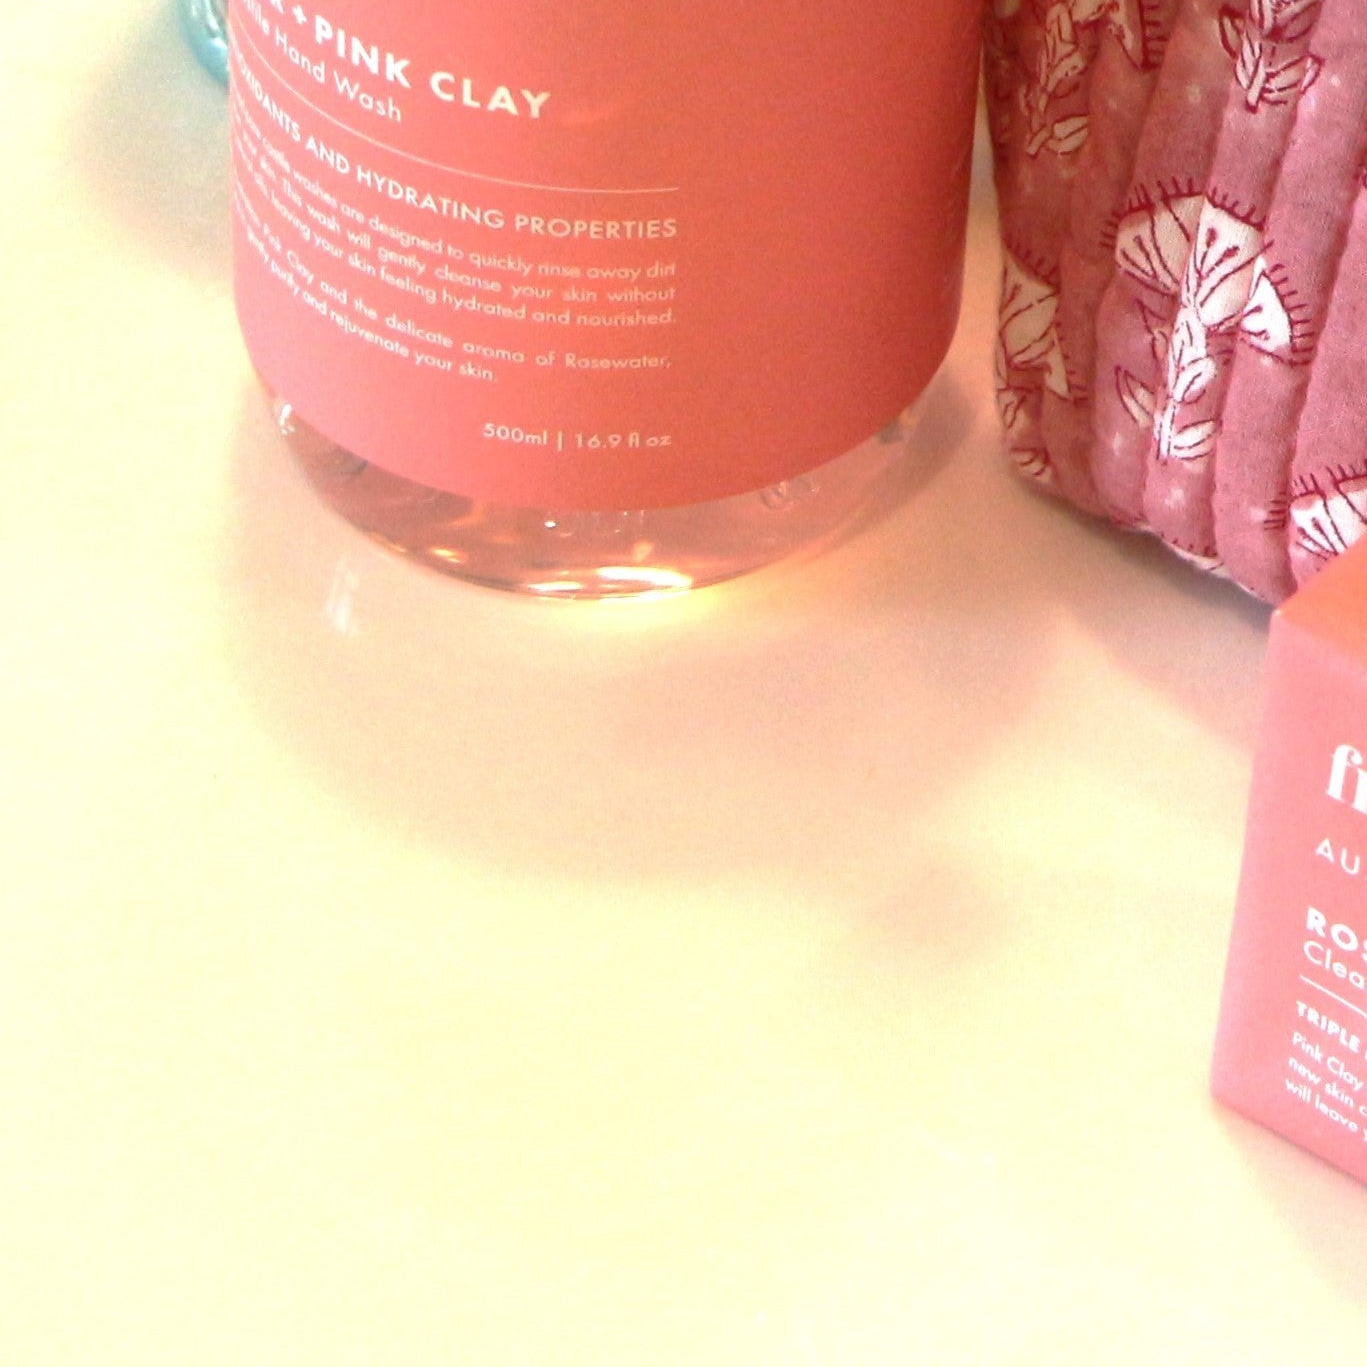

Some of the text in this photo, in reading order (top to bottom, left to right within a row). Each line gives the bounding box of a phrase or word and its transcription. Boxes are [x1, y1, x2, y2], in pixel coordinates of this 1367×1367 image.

[275, 26, 325, 84] Hand
[333, 69, 401, 122] Wash
[315, 14, 411, 89] PINK
[430, 71, 551, 119] CLAY
[305, 136, 350, 174] AND
[357, 164, 505, 229] HYDRATING
[515, 213, 677, 240] PROPERTIES
[313, 232, 344, 260] your
[348, 251, 377, 278] skin
[380, 264, 437, 305] feeling
[442, 286, 527, 322] hydrated
[532, 307, 571, 326] and
[340, 203, 365, 224] are
[369, 213, 443, 255] designed
[447, 244, 464, 261] to
[469, 251, 532, 278] quickly
[538, 263, 581, 279] rinse
[587, 267, 641, 287] away
[646, 260, 676, 279] dirt
[347, 228, 372, 251] will
[377, 245, 426, 276] gently
[434, 264, 502, 293] cleanse
[511, 284, 553, 300] your
[563, 284, 597, 303] skin
[607, 286, 676, 304] without
[302, 290, 328, 316] and
[330, 308, 410, 358] rejuvenate
[413, 350, 453, 373] your
[320, 279, 347, 305] and
[354, 297, 378, 320] the
[385, 312, 454, 349] delicate
[463, 339, 526, 364] aroma
[535, 350, 557, 367] of
[483, 422, 673, 449] 500ml 16.9 fl oz
[1292, 1031, 1324, 1064] Pink
[1326, 1056, 1365, 1092] Clay
[1295, 999, 1361, 1054] TRIPLE
[1285, 1077, 1312, 1104] will
[1314, 1093, 1359, 1134] leave
[1287, 1055, 1322, 1085] new
[1324, 1077, 1355, 1108] skin
